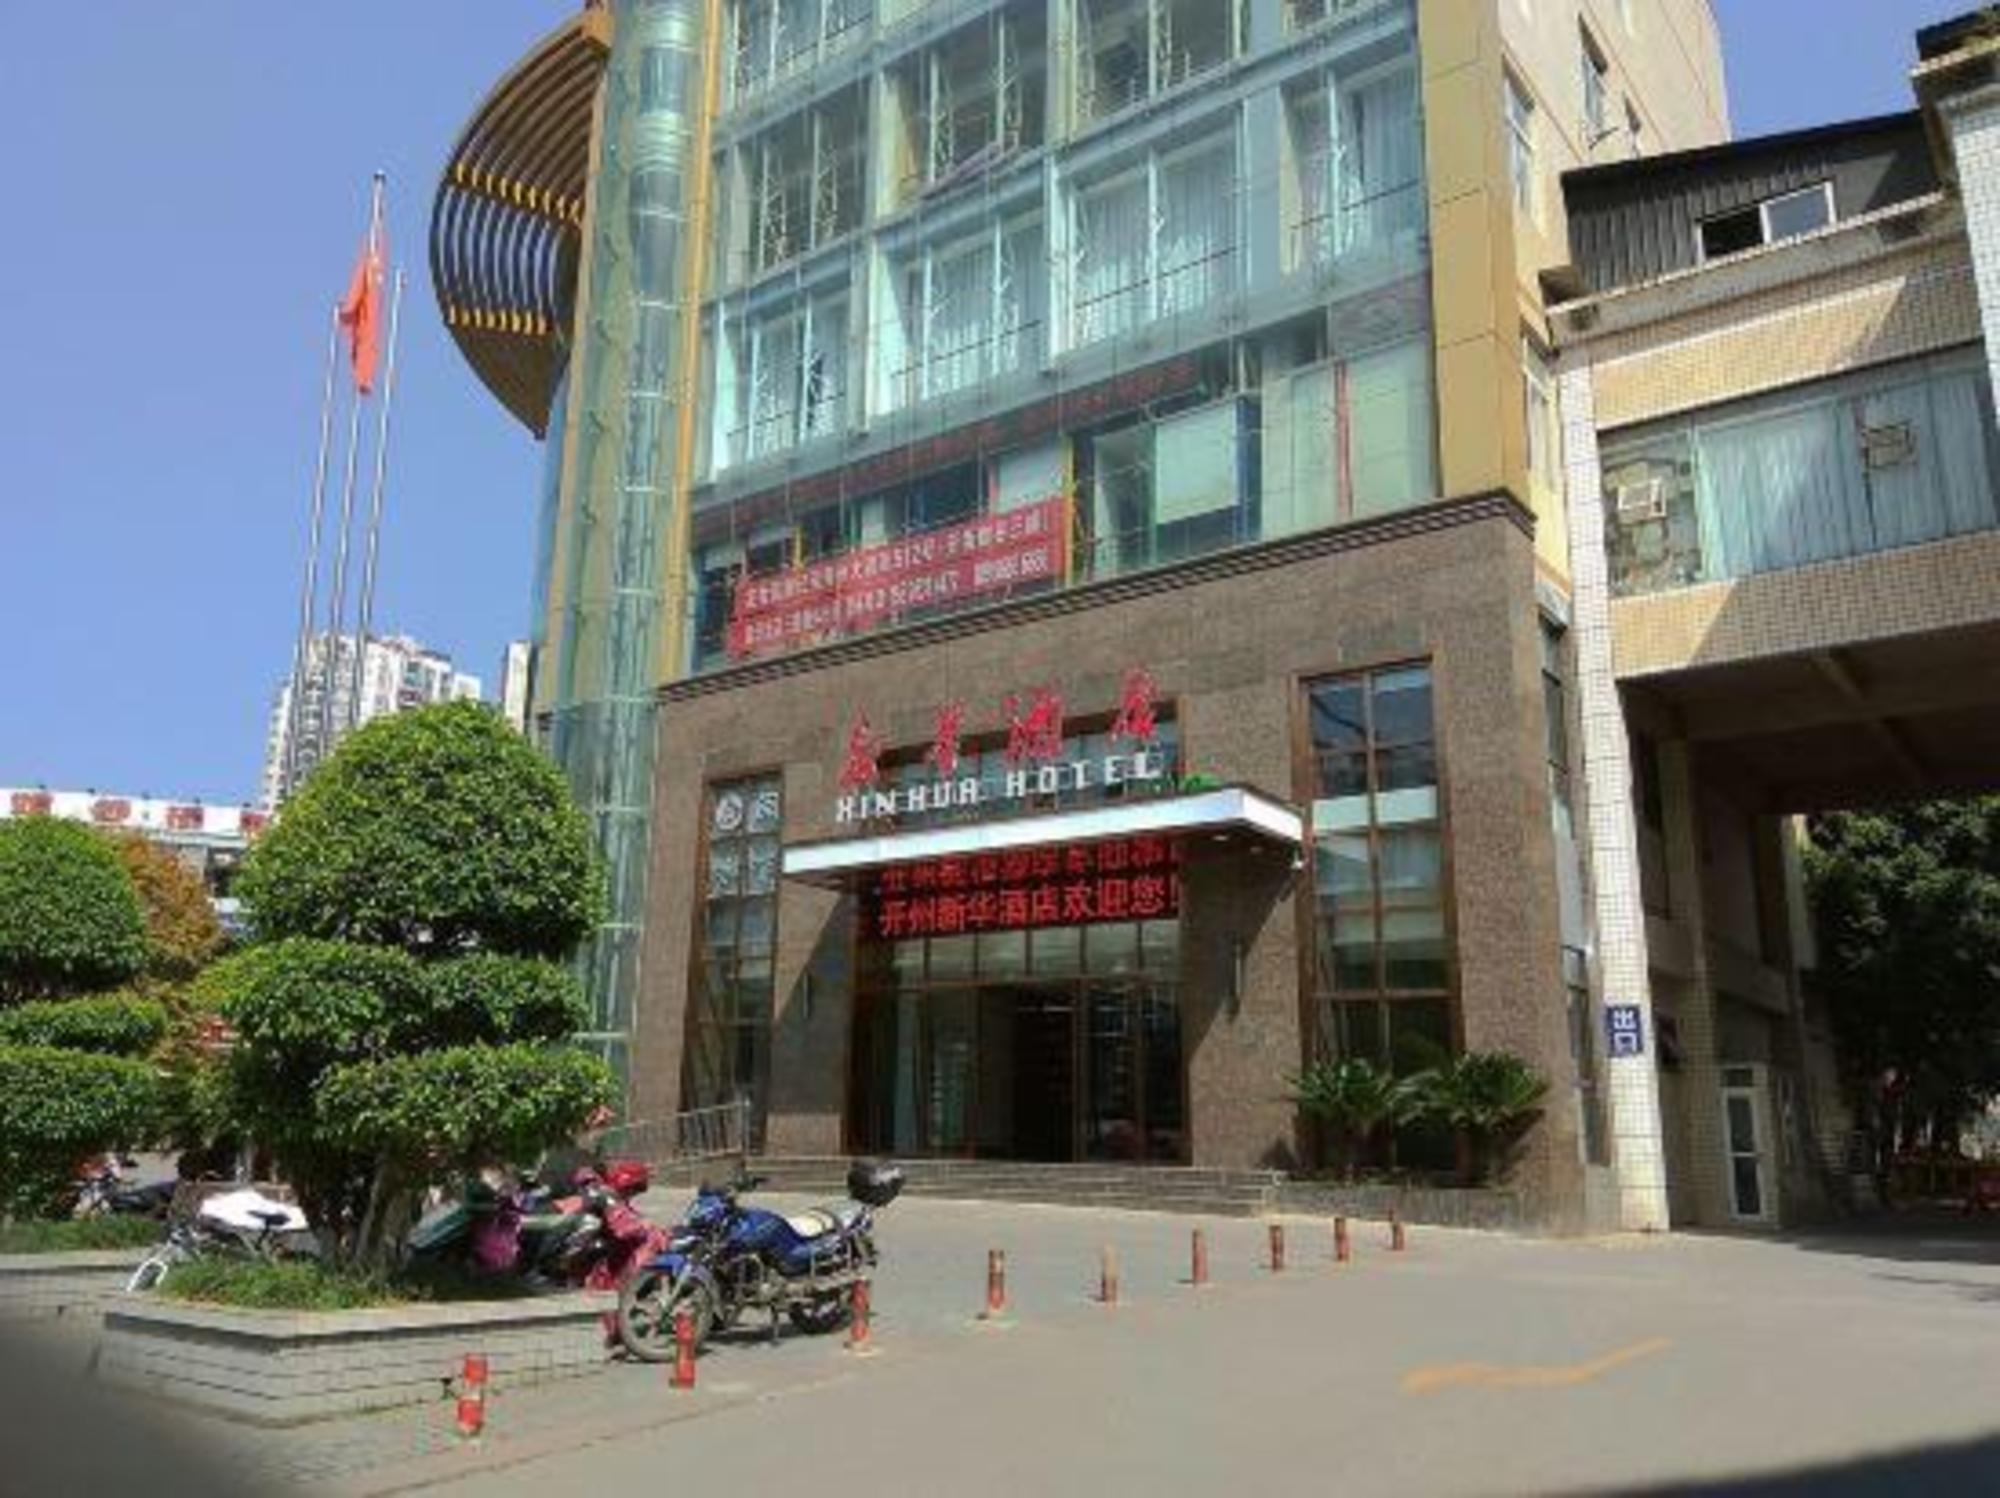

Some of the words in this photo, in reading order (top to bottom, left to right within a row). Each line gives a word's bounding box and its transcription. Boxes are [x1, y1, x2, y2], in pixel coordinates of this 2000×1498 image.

[836, 776, 978, 822] XINHUA
[1005, 752, 1162, 798] HOTEL
[1612, 1009, 1638, 1054] 出口
